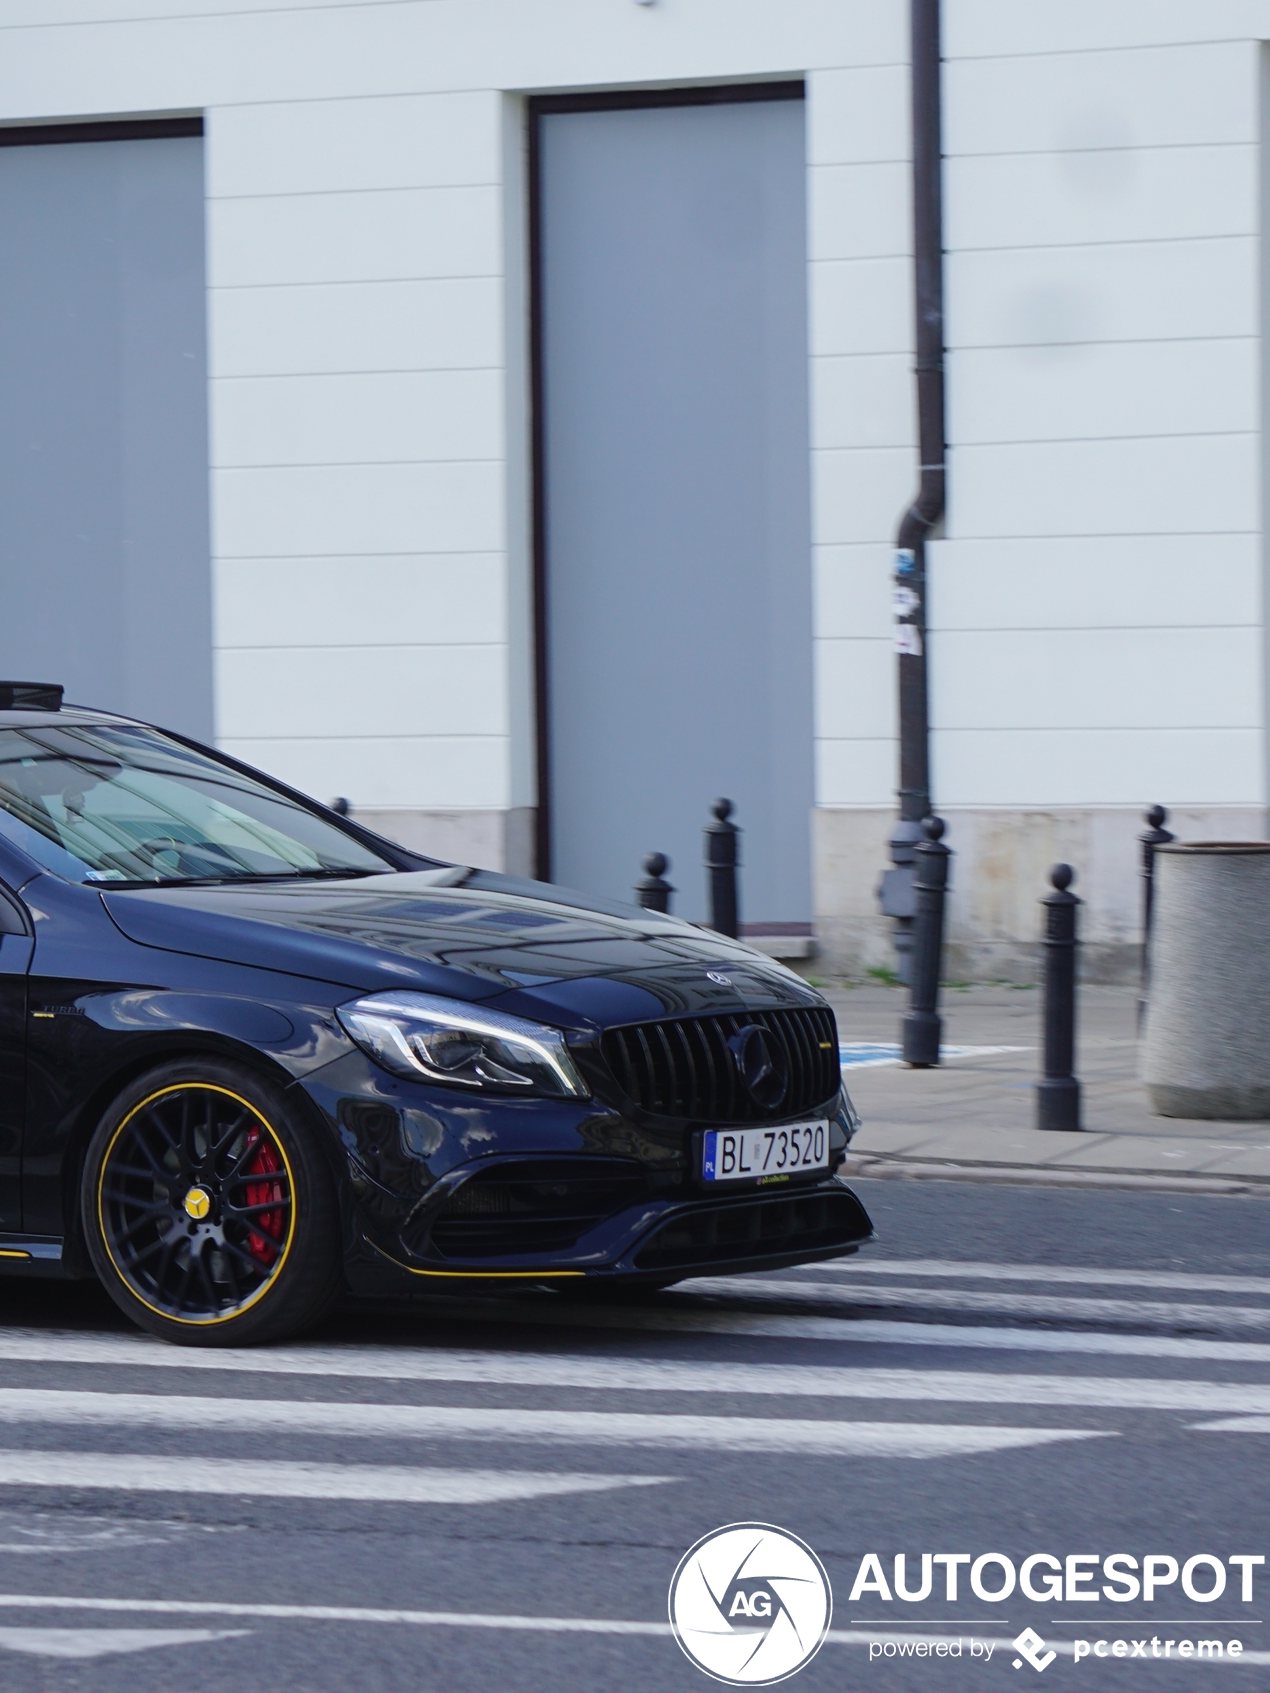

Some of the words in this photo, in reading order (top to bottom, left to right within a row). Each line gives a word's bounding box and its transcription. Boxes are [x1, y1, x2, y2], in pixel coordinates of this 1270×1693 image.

[721, 1134, 751, 1174] BL
[762, 1125, 824, 1171] 73520
[705, 1161, 715, 1173] PL
